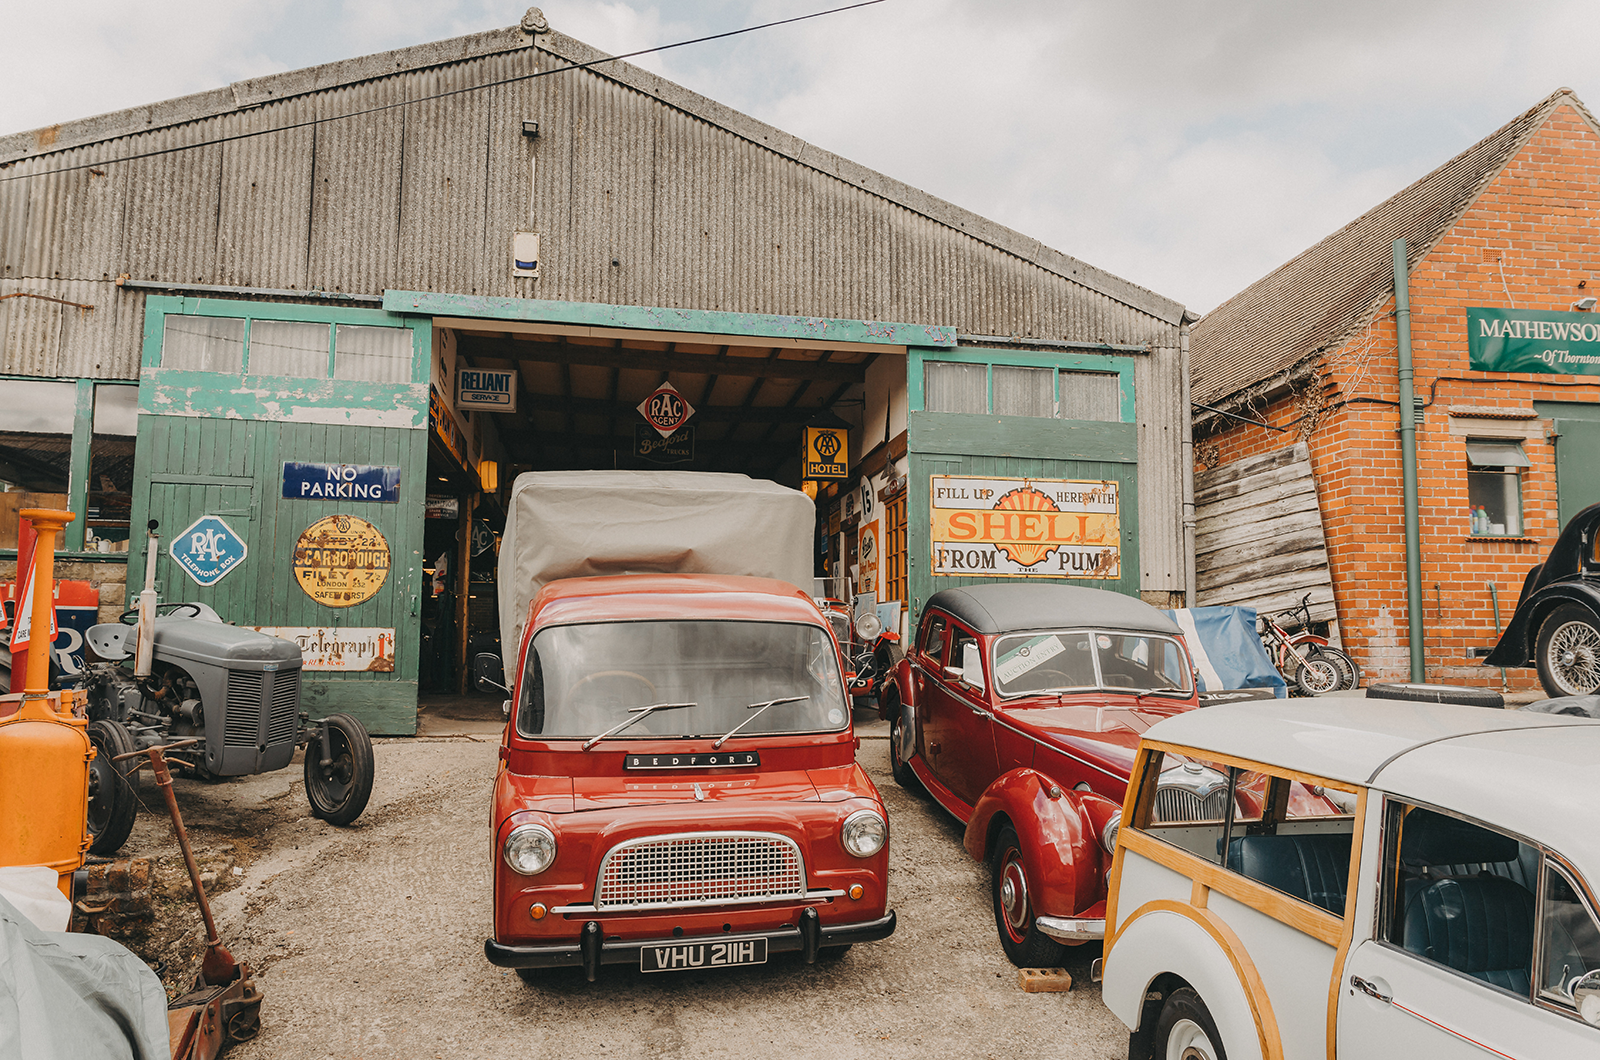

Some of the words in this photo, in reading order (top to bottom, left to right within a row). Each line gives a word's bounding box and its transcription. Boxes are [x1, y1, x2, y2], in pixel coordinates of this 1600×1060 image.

[461, 371, 511, 392] RELIANT
[471, 393, 500, 401] SERVICE
[651, 394, 682, 417] RAC
[653, 416, 679, 425] AGENT
[327, 466, 357, 481] NO
[811, 464, 845, 474] HOTEL
[301, 481, 382, 498] PARKING
[937, 487, 969, 500] FILL
[974, 488, 994, 500] UP
[471, 525, 488, 549] AC
[948, 512, 1105, 543] SHELL
[190, 529, 226, 561] RAC
[181, 553, 221, 577] TELEPHONE
[220, 555, 236, 569] BOX
[937, 549, 997, 569] FROM
[1058, 551, 1112, 572] PUM
[302, 570, 350, 580] FILEY
[345, 592, 366, 600] RST
[295, 633, 376, 658] Telegraph
[1003, 656, 1037, 680] AUCTION
[1036, 643, 1061, 660] ENTRY
[633, 755, 753, 766] BEDFORD
[655, 945, 705, 969] VHU
[711, 941, 754, 965] 211H
